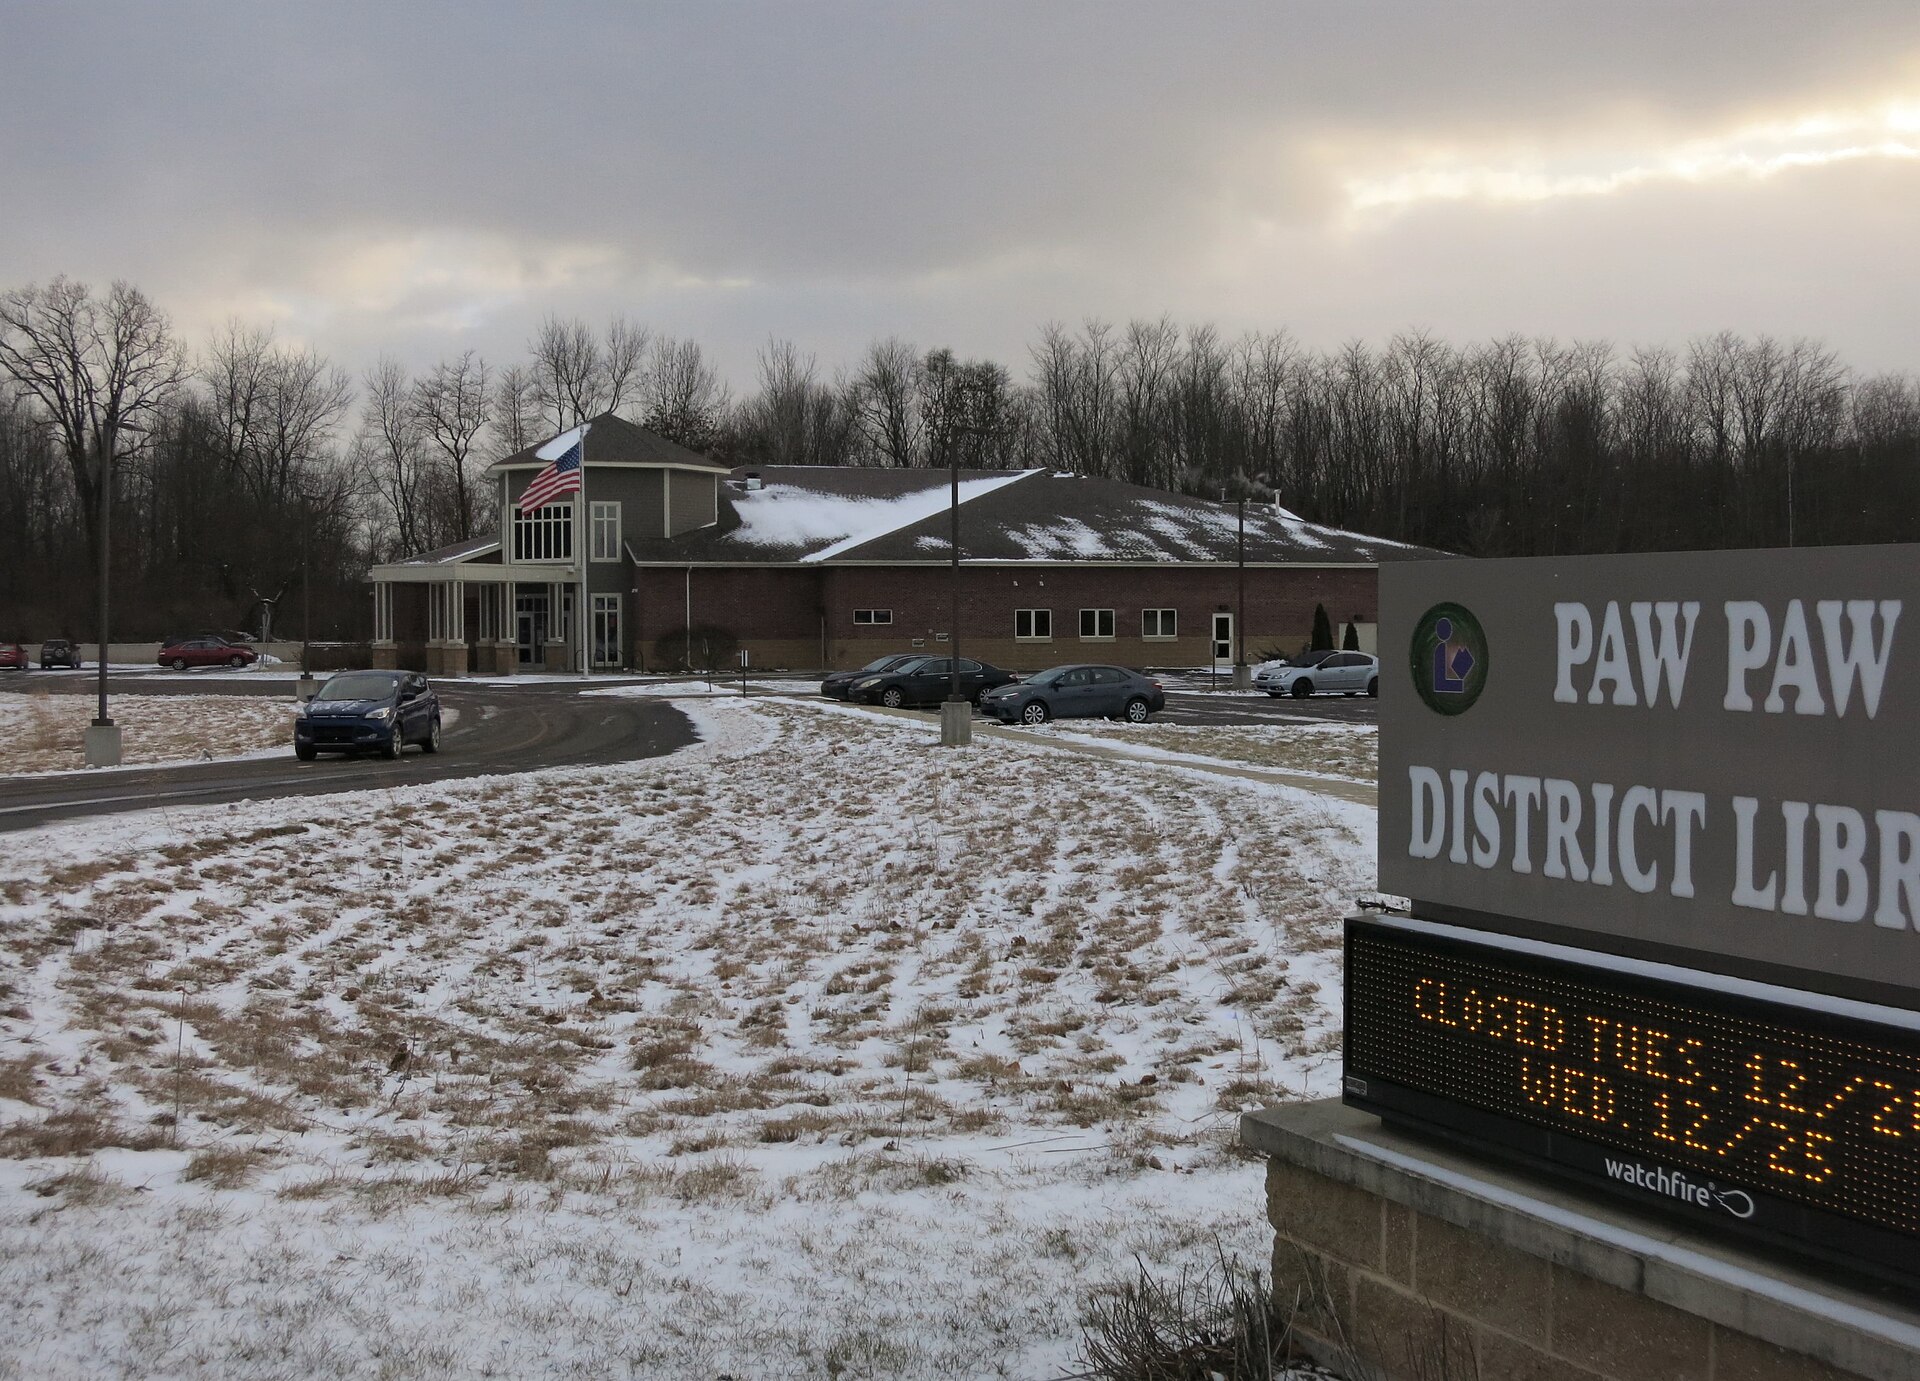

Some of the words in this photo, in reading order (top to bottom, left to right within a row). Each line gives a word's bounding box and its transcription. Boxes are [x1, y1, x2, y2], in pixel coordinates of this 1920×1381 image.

[1553, 600, 1700, 710] PAW
[1723, 598, 1902, 720] PAW
[1408, 764, 1706, 899] DISTRICT
[1414, 977, 1565, 1052] CLOSED
[1585, 1014, 1719, 1093] TUES.
[1520, 1056, 1630, 1129] WED.
[1651, 1092, 1835, 1184] 12/25
